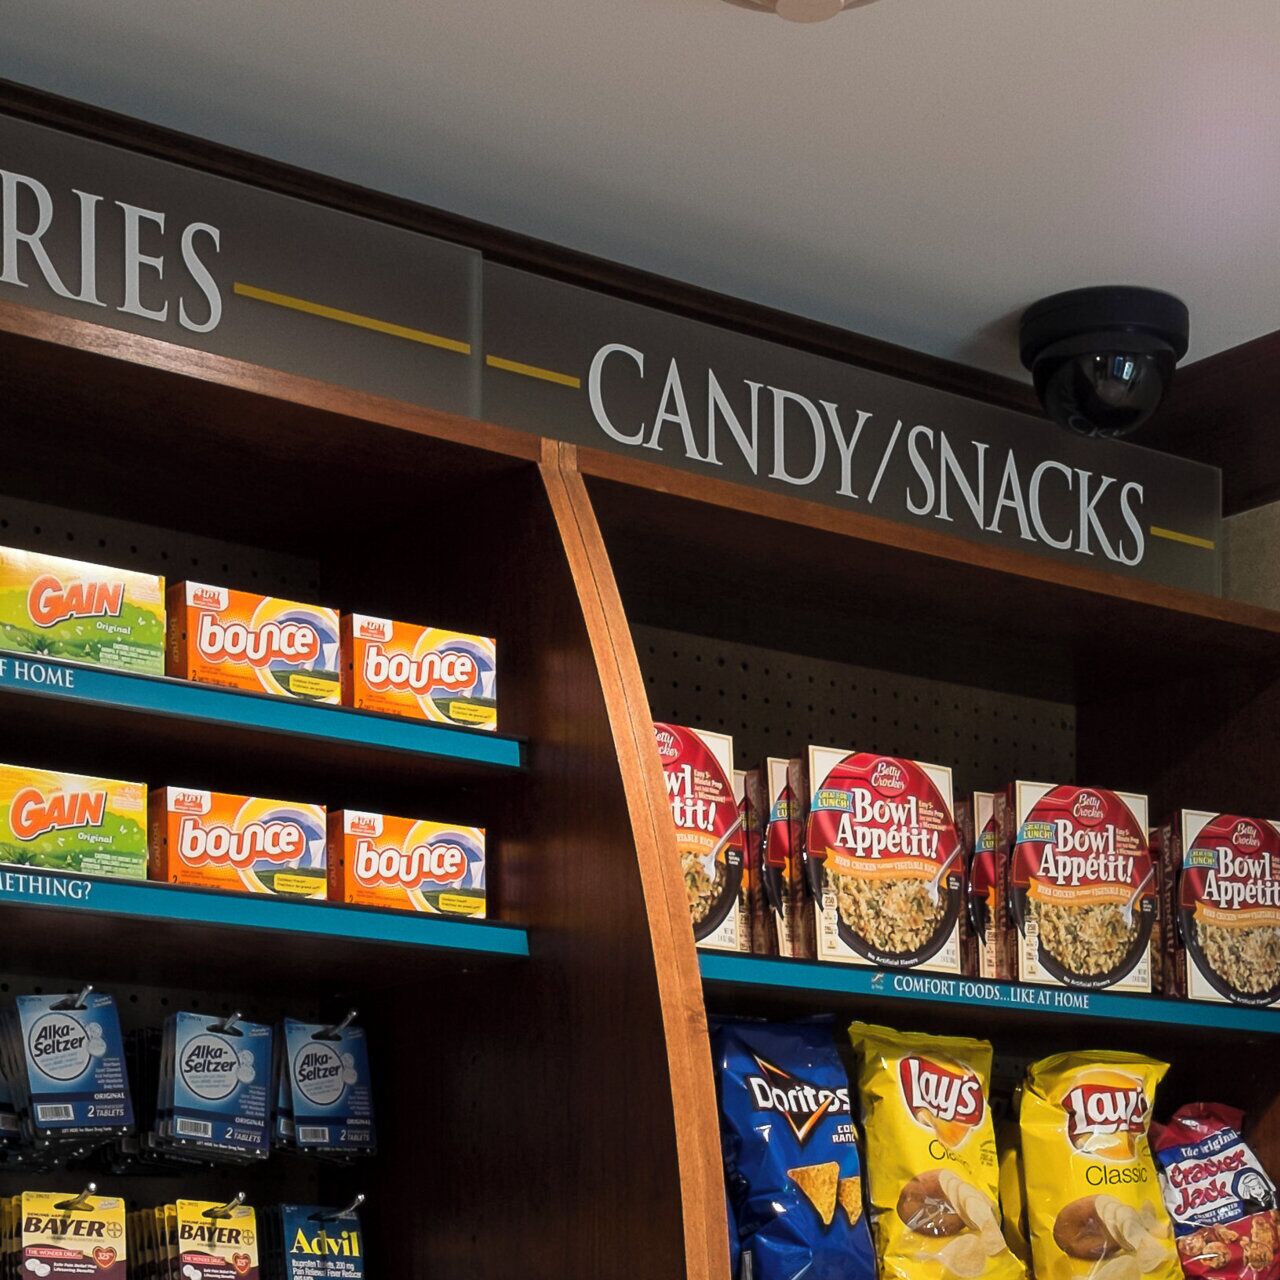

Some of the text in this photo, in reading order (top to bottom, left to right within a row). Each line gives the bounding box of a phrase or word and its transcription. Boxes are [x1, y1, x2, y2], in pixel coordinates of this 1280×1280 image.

[588, 343, 1145, 566] CANDY/SNACKS
[28, 575, 124, 627] GAIN
[96, 621, 131, 634] Original
[199, 612, 320, 668] bounce
[13, 662, 75, 688] HOME
[365, 644, 477, 695] bounce
[817, 798, 850, 809] LUNCH!
[851, 788, 918, 829] Bowl
[835, 813, 939, 858] Appétit!
[1054, 819, 1116, 853] Bowl
[894, 976, 957, 997] COMFORT
[1037, 989, 1053, 1006] AT
[1055, 991, 1090, 1009] HOME
[34, 1036, 85, 1057] Seltzer
[184, 1059, 236, 1073] Seltzer
[749, 1076, 850, 1114] Doritos
[908, 1058, 980, 1121] Lay's
[87, 1105, 124, 1117] 2 TABLETS
[1085, 1165, 1148, 1186] Classic
[1169, 1148, 1248, 1188] Cracker
[1174, 1179, 1234, 1215] Jack
[24, 1217, 106, 1237] BAYER
[180, 1224, 242, 1244] BAYER
[290, 1227, 360, 1257] Advil
